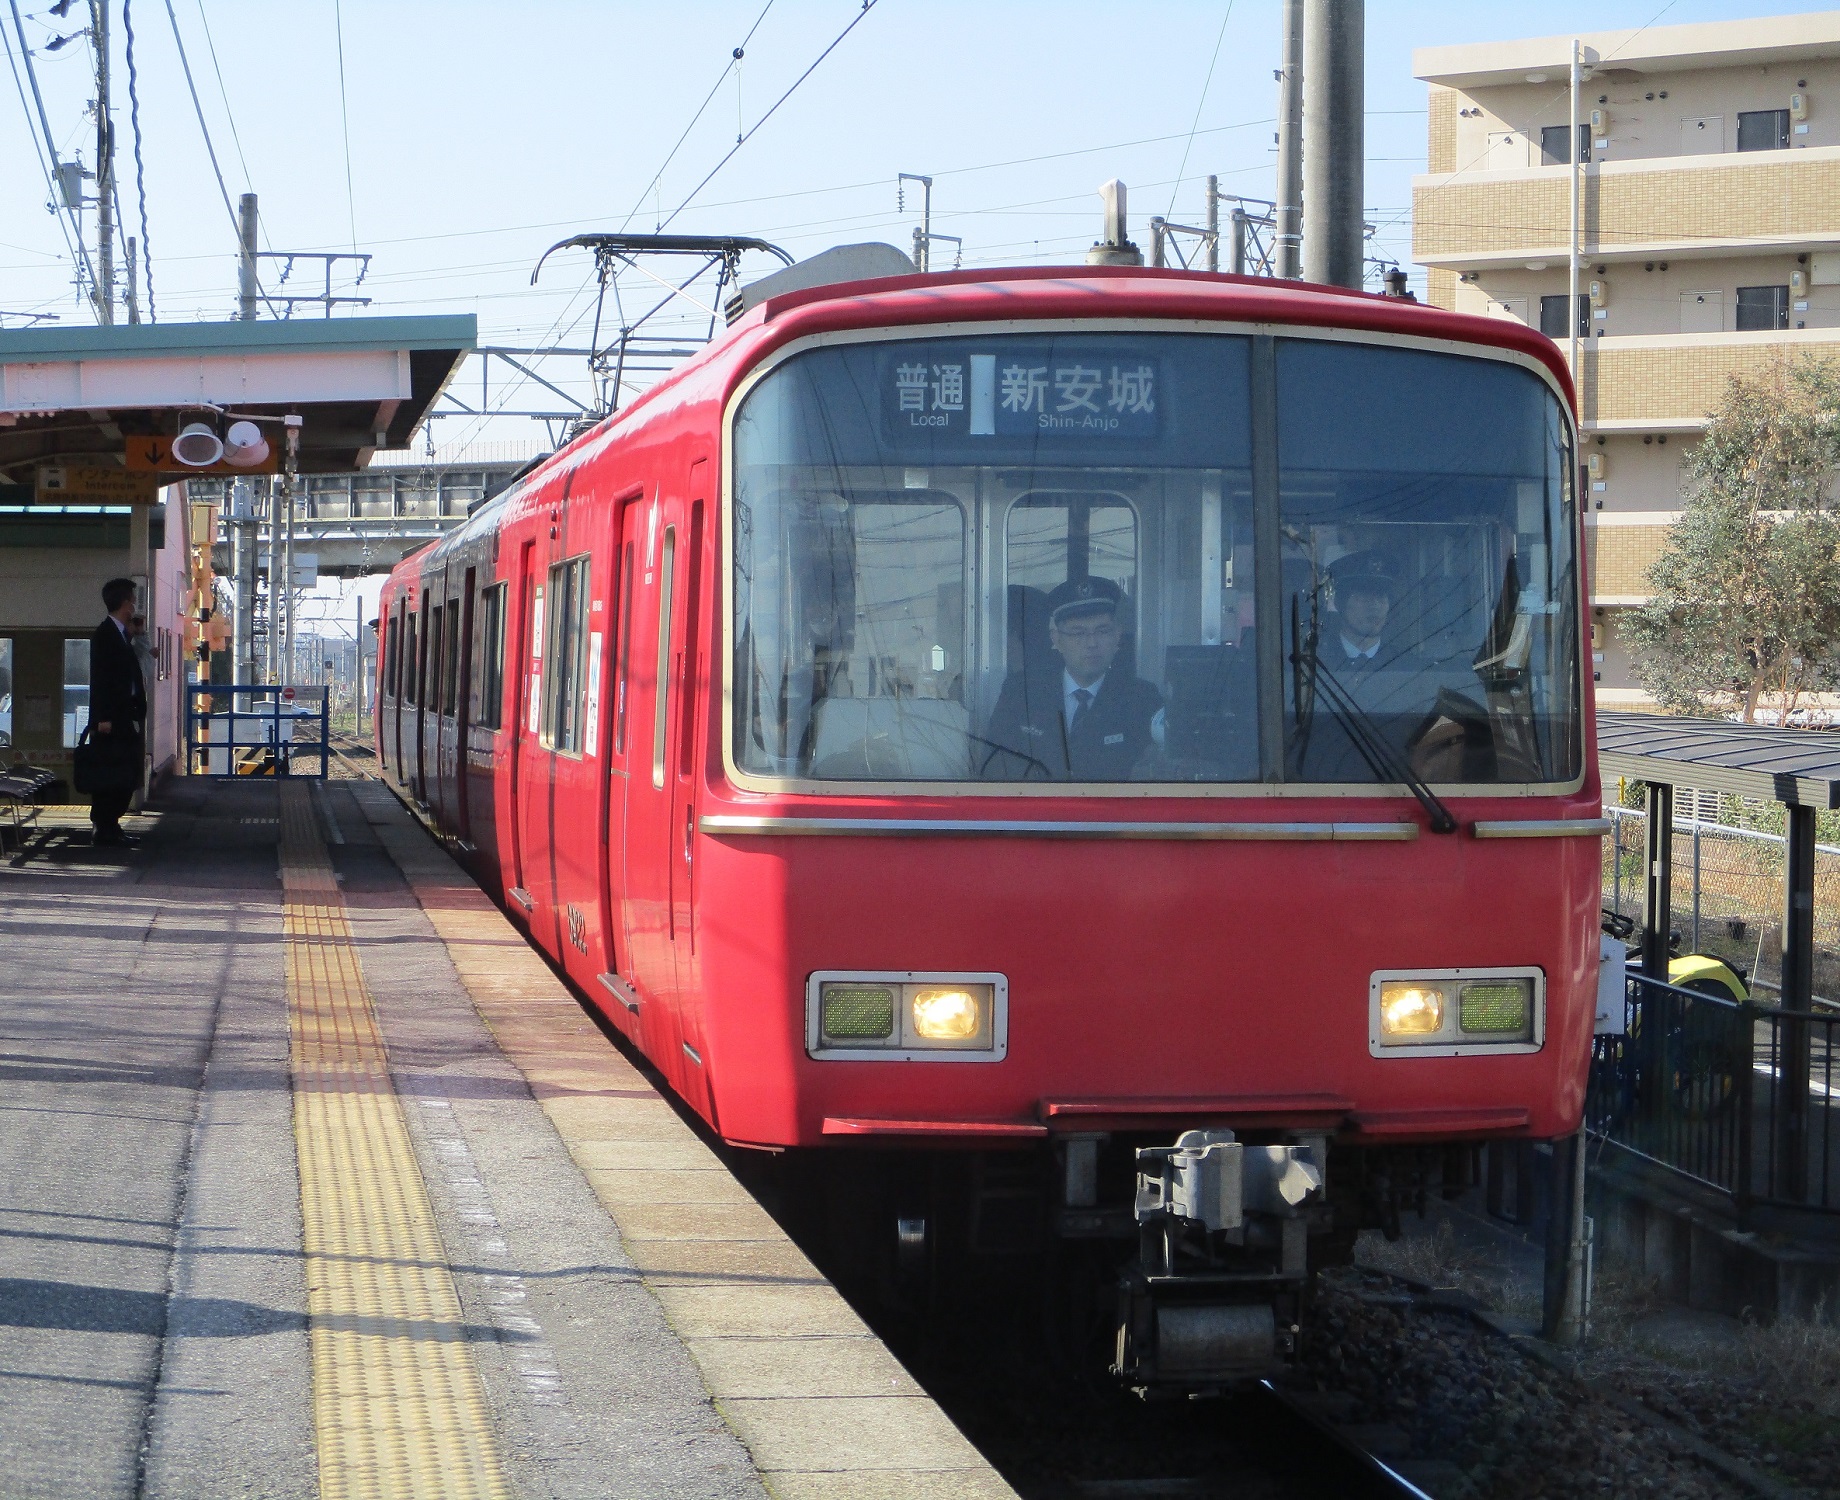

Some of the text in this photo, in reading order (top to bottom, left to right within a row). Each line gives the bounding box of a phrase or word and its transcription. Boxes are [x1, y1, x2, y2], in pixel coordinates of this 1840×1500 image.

[896, 362, 964, 411] 普通
[1001, 364, 1156, 413] 新安城
[910, 413, 949, 426] Local
[1038, 414, 1119, 431] Shin-Anjo
[85, 481, 137, 490] Intercom
